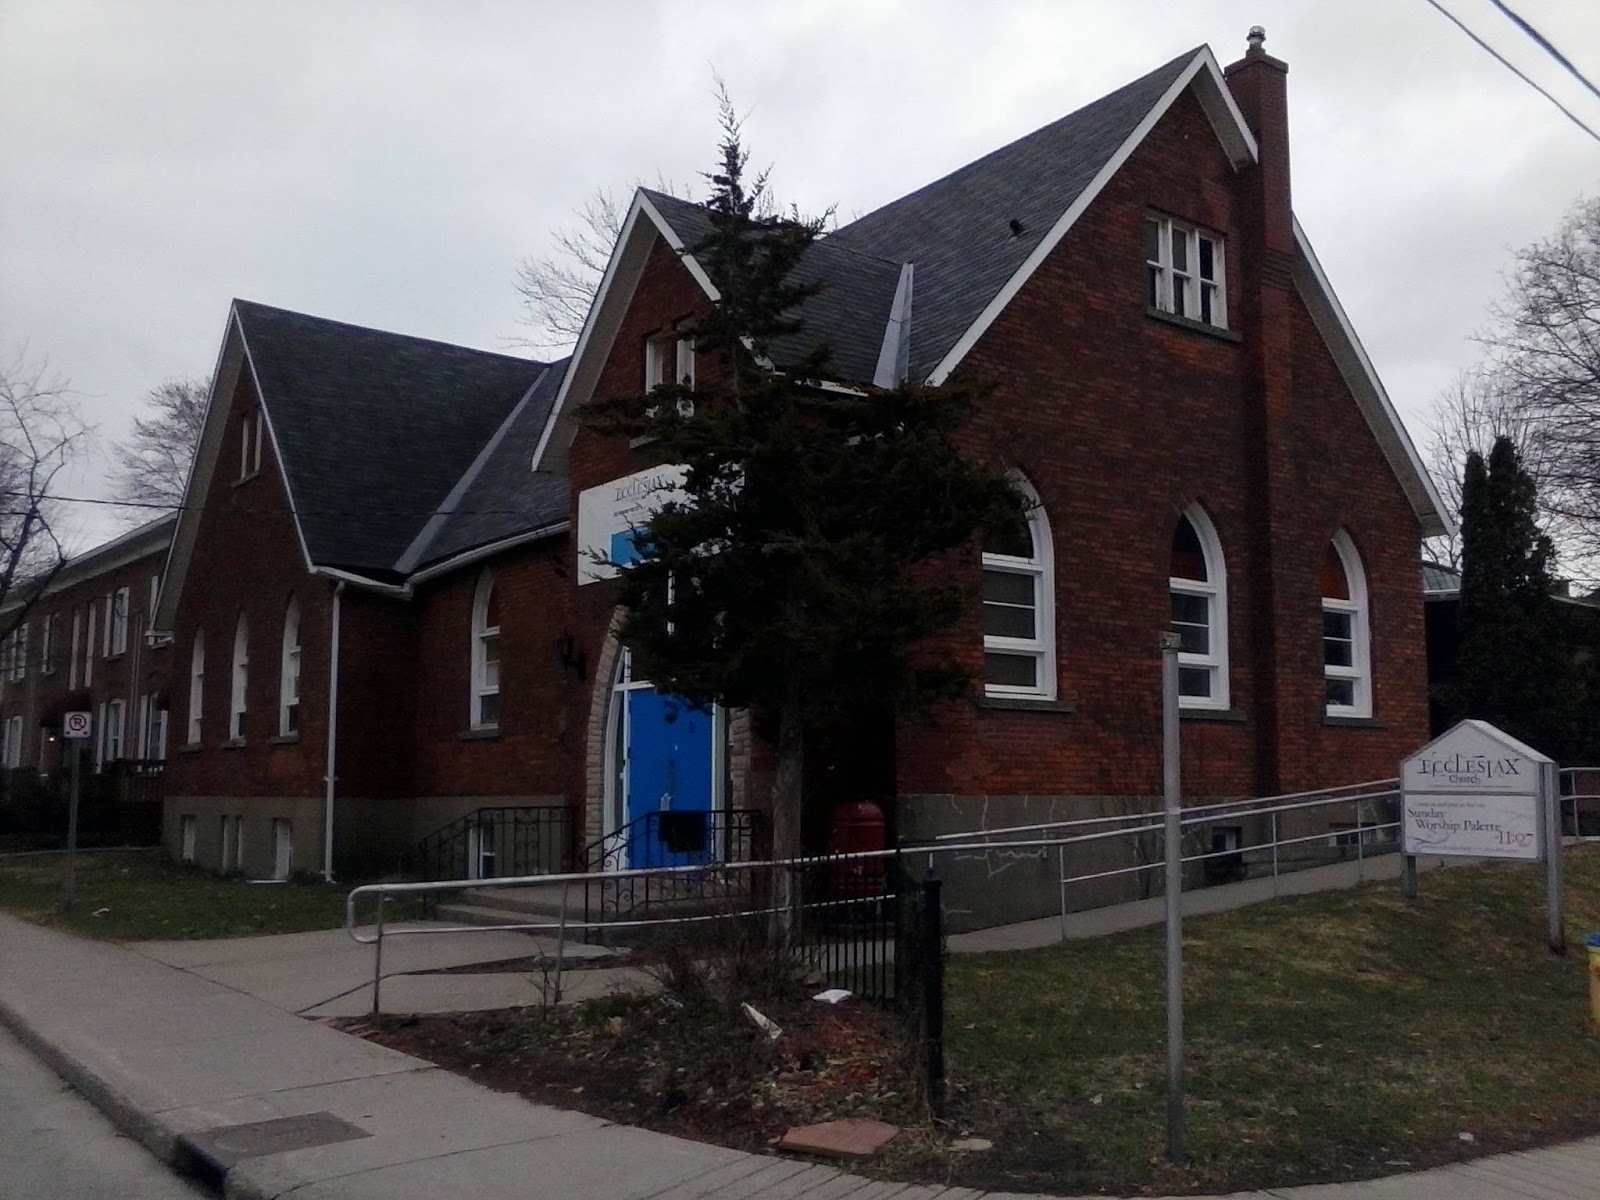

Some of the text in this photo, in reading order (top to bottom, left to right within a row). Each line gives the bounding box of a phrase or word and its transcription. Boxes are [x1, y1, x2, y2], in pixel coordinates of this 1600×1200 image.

[1448, 774, 1481, 784] Church
[1407, 808, 1446, 819] Sunday
[1415, 819, 1501, 833] Worship Palette
